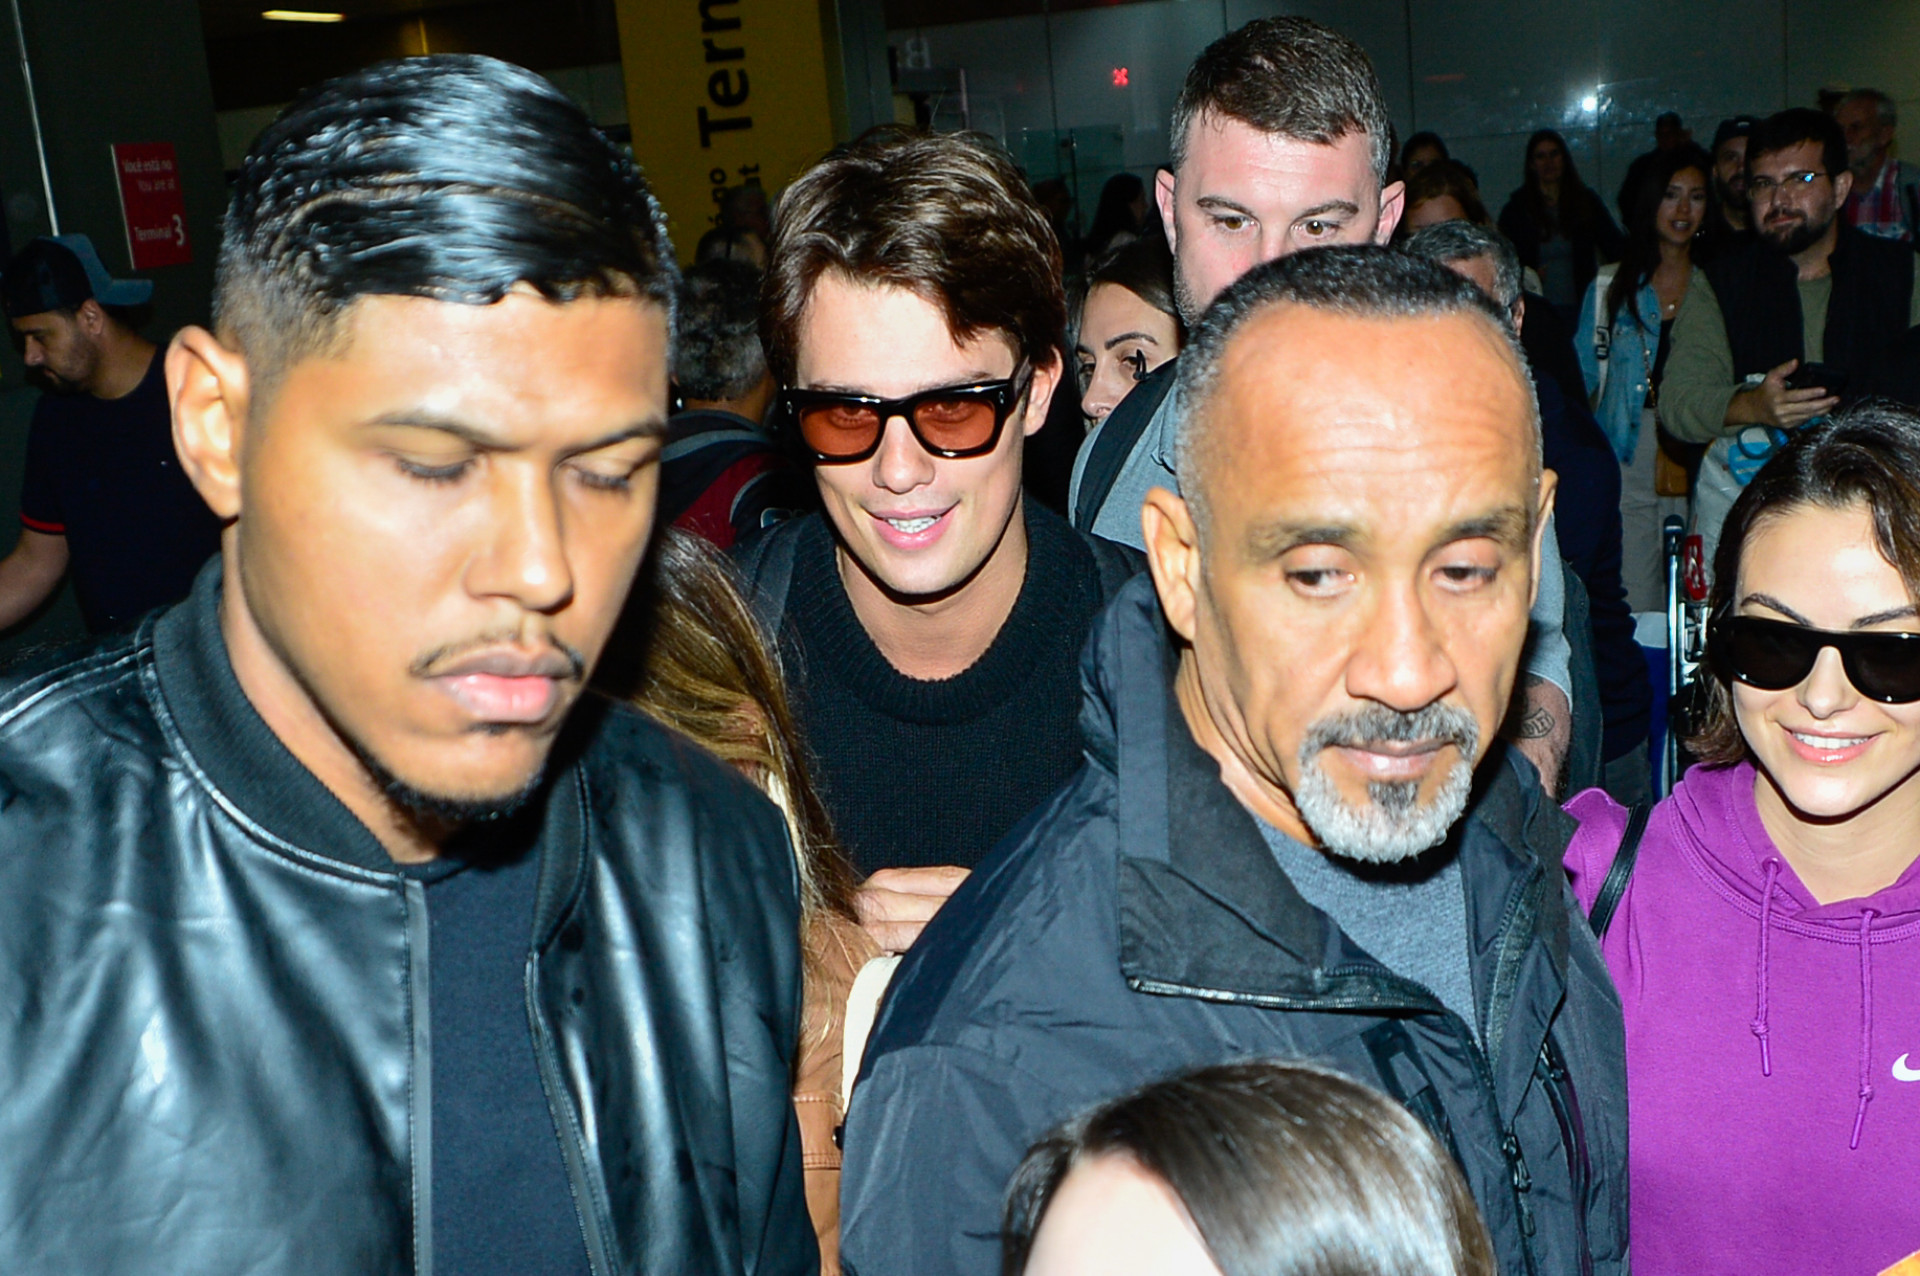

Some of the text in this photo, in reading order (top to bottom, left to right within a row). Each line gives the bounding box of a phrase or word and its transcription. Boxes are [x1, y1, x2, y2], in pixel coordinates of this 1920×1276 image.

[122, 157, 142, 172] Você
[161, 159, 173, 170] no
[134, 213, 184, 246] Terminal 3
